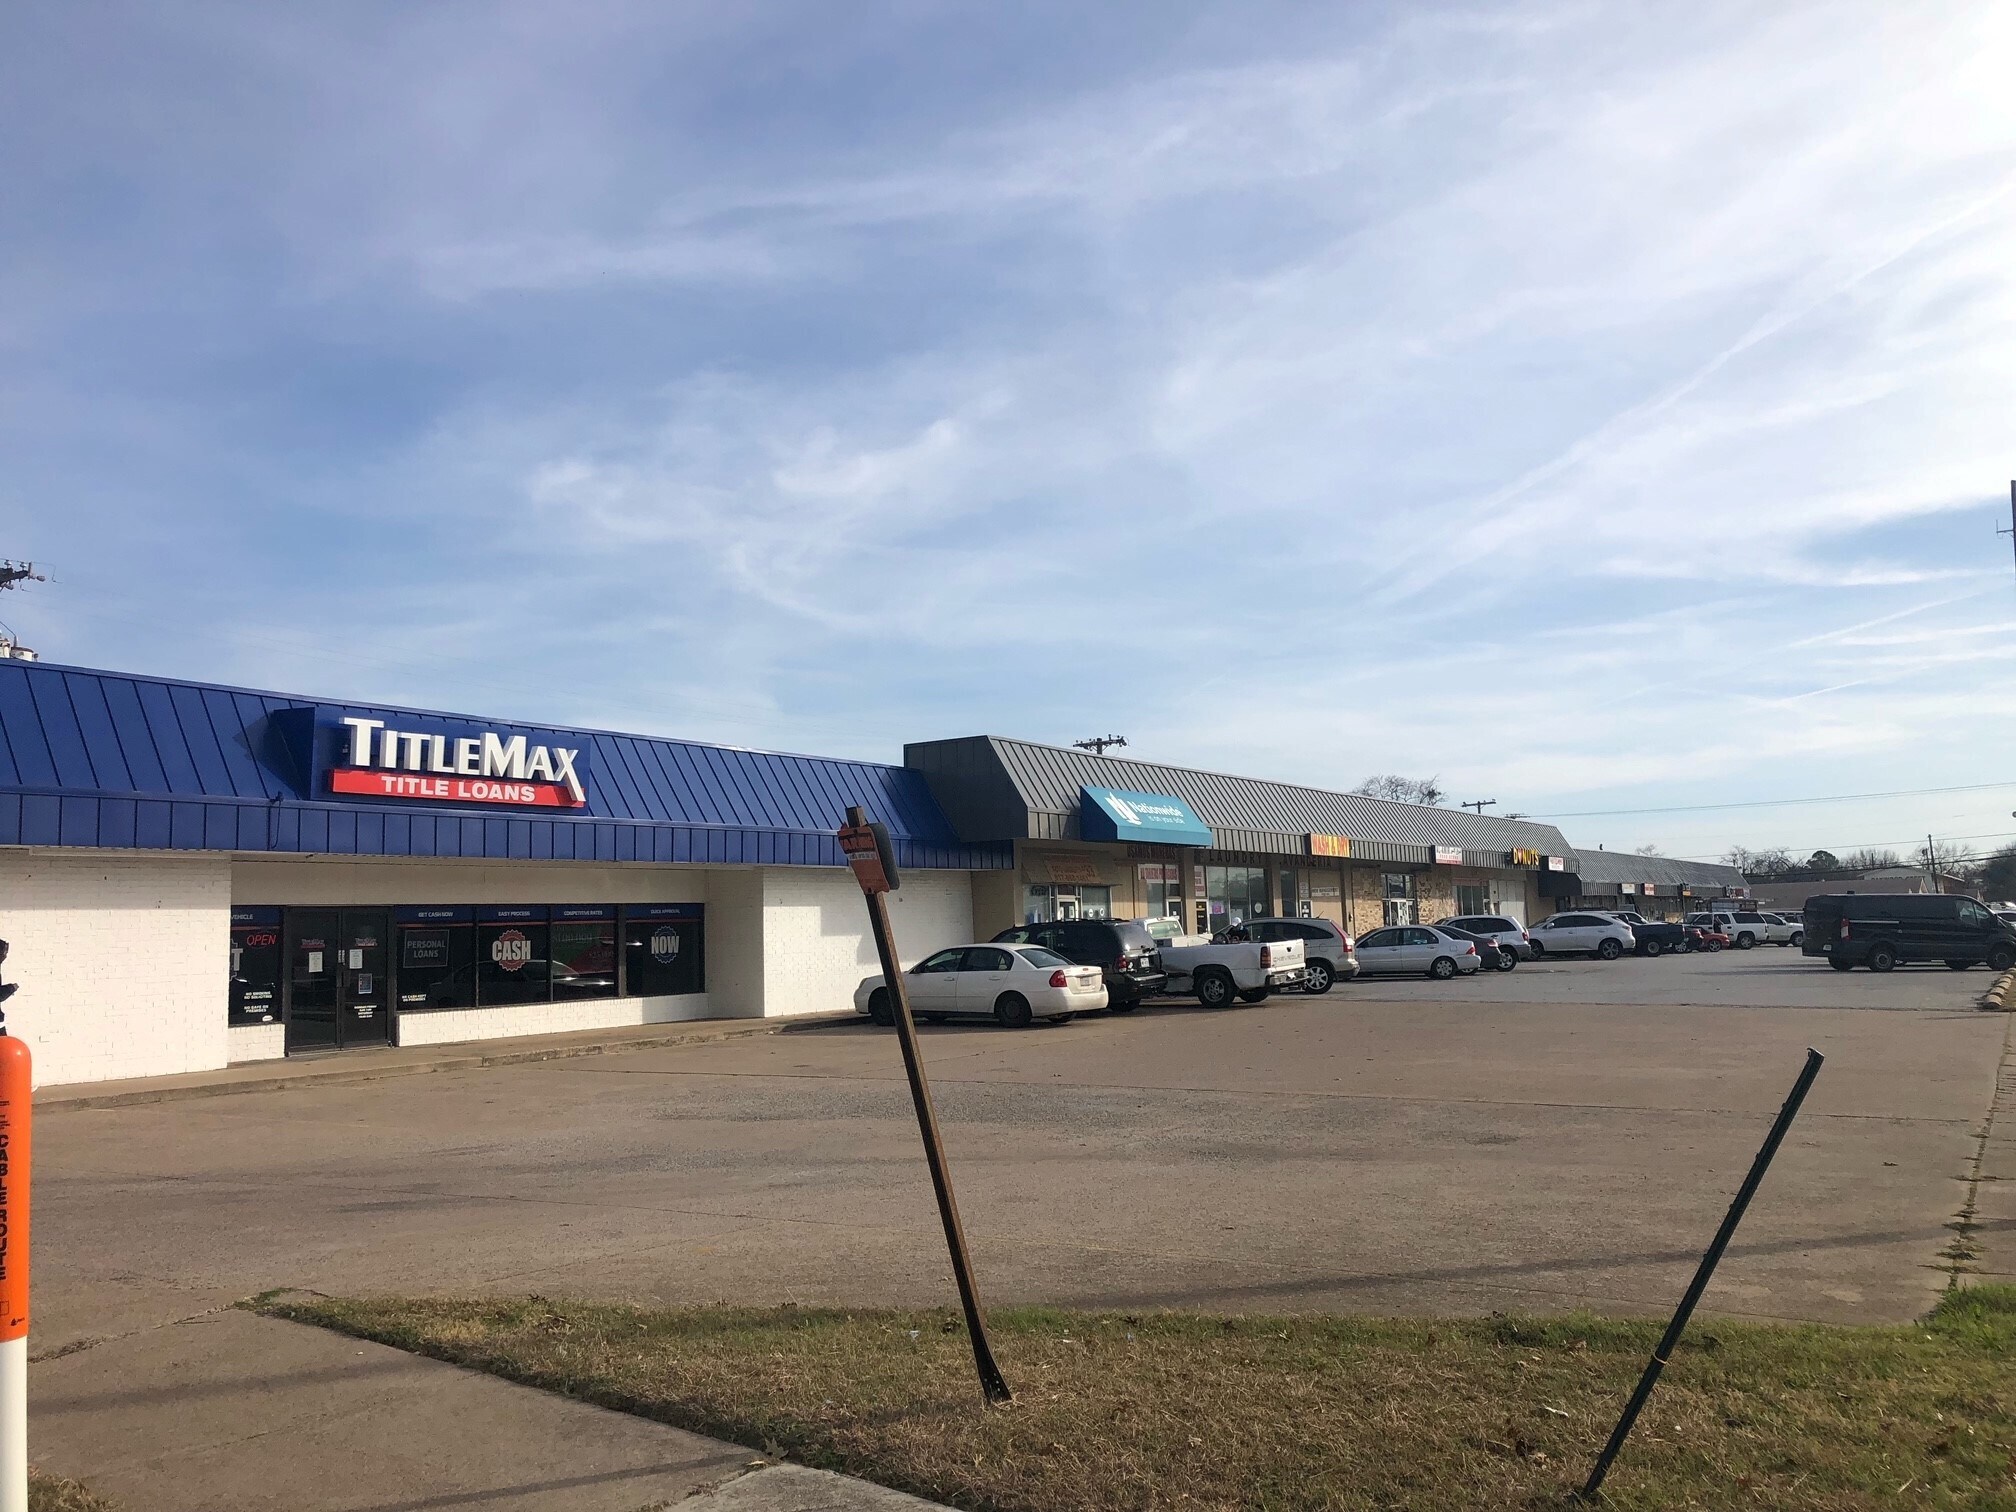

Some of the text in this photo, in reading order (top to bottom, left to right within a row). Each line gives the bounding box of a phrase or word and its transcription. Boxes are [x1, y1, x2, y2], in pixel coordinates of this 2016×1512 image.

[381, 775, 536, 802] TITLE LOANS
[1126, 800, 1184, 818] Nationwide
[1312, 834, 1328, 855] WASH
[1338, 836, 1349, 857] DRY
[1209, 850, 1262, 865] LAUNDRY
[246, 934, 277, 946] OPEN
[407, 940, 446, 949] PERSONAL
[651, 935, 680, 955] NOW
[413, 949, 439, 959] LOANS
[491, 940, 532, 961] CASH
